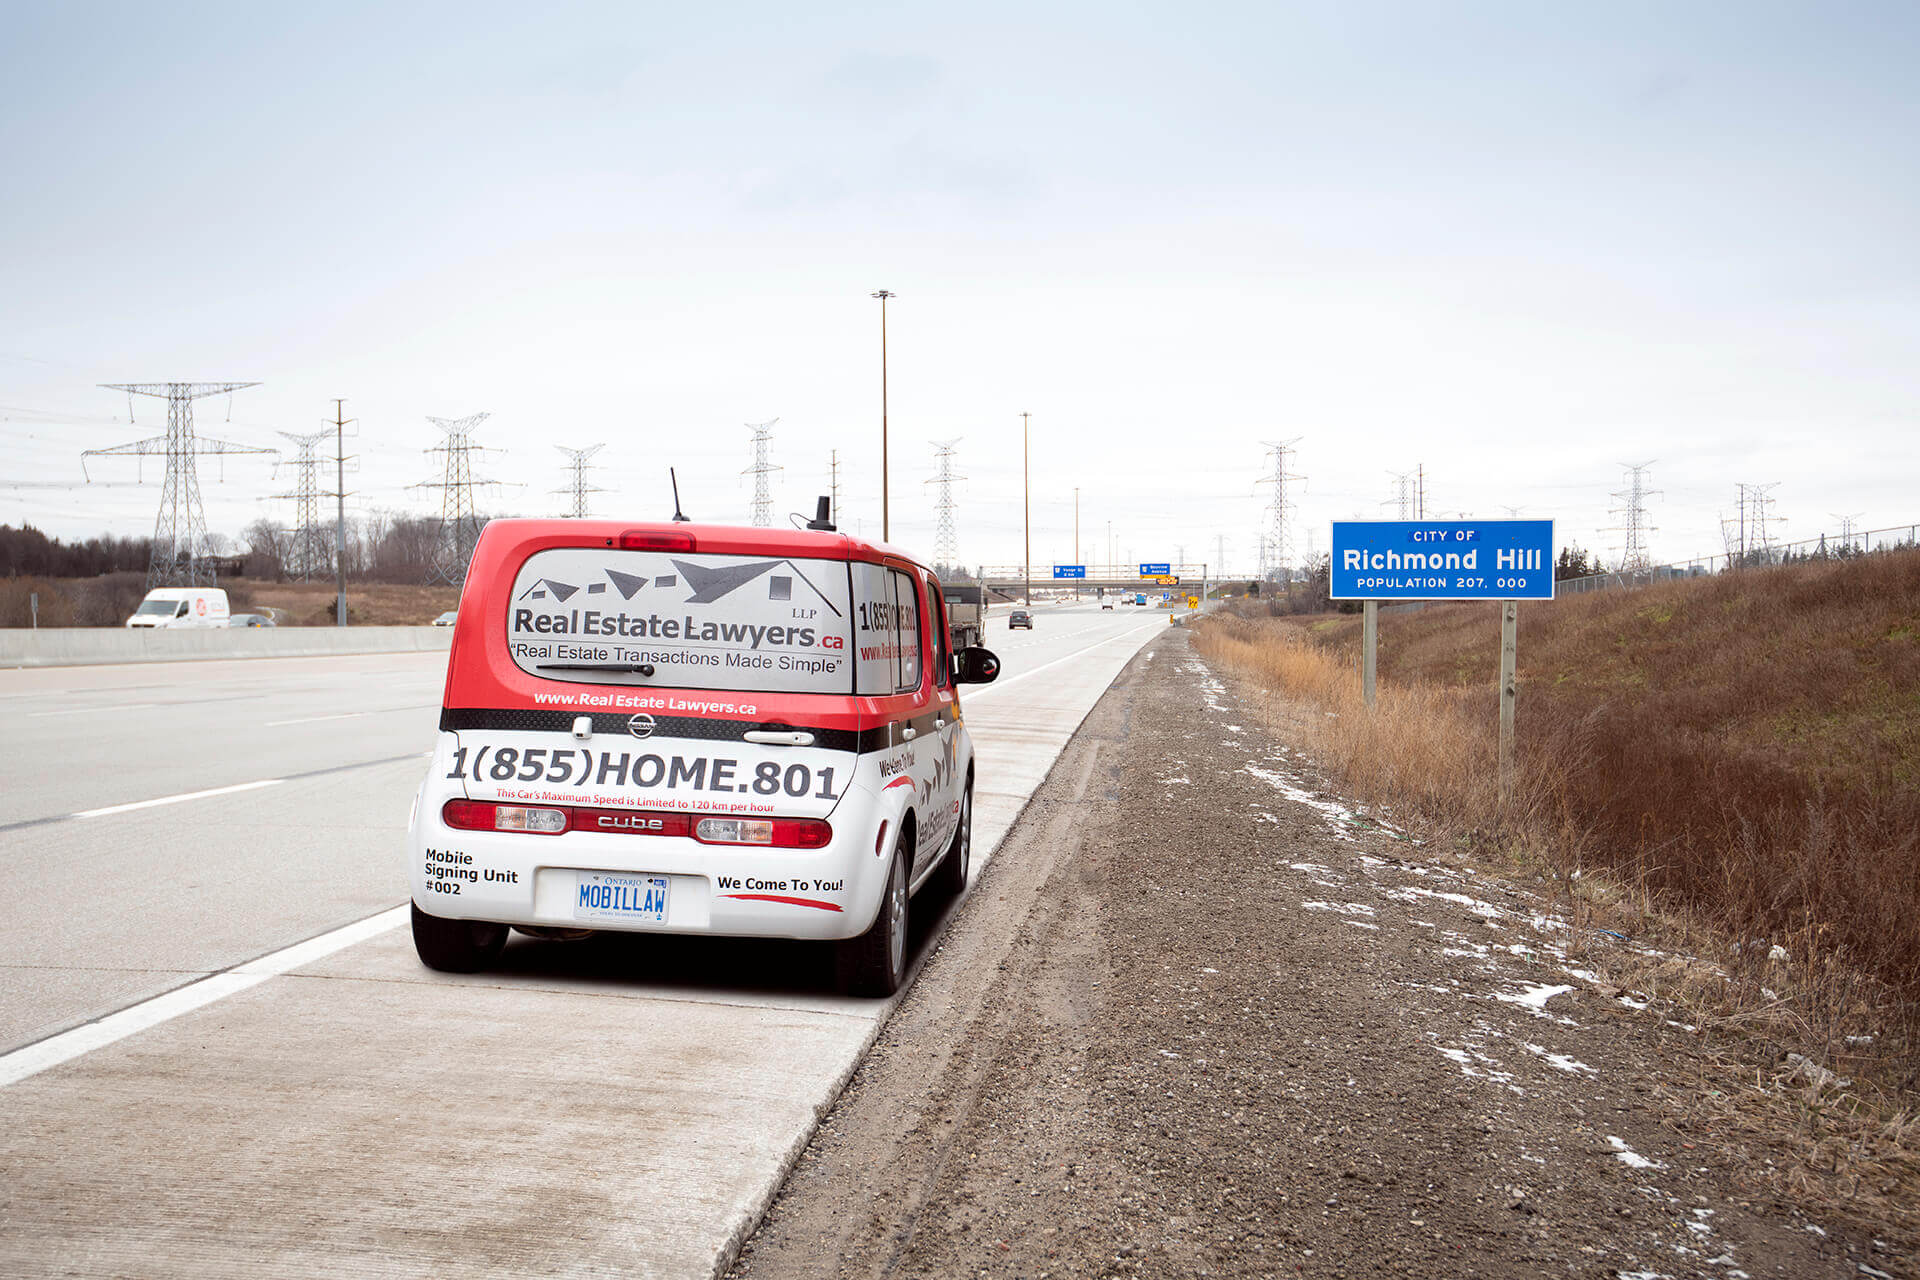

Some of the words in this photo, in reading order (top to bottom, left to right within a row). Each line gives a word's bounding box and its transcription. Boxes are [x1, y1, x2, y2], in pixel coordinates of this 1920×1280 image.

[1413, 530, 1448, 542] CITY
[1455, 530, 1475, 541] OF
[1343, 549, 1477, 570] Richmond
[1496, 548, 1541, 570] Hill
[1357, 577, 1447, 588] POPULATION
[1496, 578, 1527, 588] 000
[792, 608, 817, 619] LLP
[557, 645, 608, 661] Estate
[613, 647, 720, 666] Transactions
[726, 654, 773, 669] Made
[447, 747, 839, 800] 1(855)HOME.801
[496, 788, 515, 799] This
[542, 790, 591, 804] Maximum
[594, 794, 625, 807] Speed
[627, 796, 636, 806] is
[637, 797, 676, 808] Limited
[678, 799, 689, 809] to
[691, 800, 710, 810] 120
[712, 801, 729, 811] km
[731, 804, 748, 814] per
[750, 803, 775, 813] hour
[425, 863, 478, 883] Signing
[484, 869, 519, 884] Unit
[717, 877, 741, 889] We
[745, 877, 787, 890] Come
[791, 879, 809, 891] To
[813, 879, 843, 891] You!
[426, 879, 461, 895] #002
[579, 884, 665, 913] MOBILLAW
